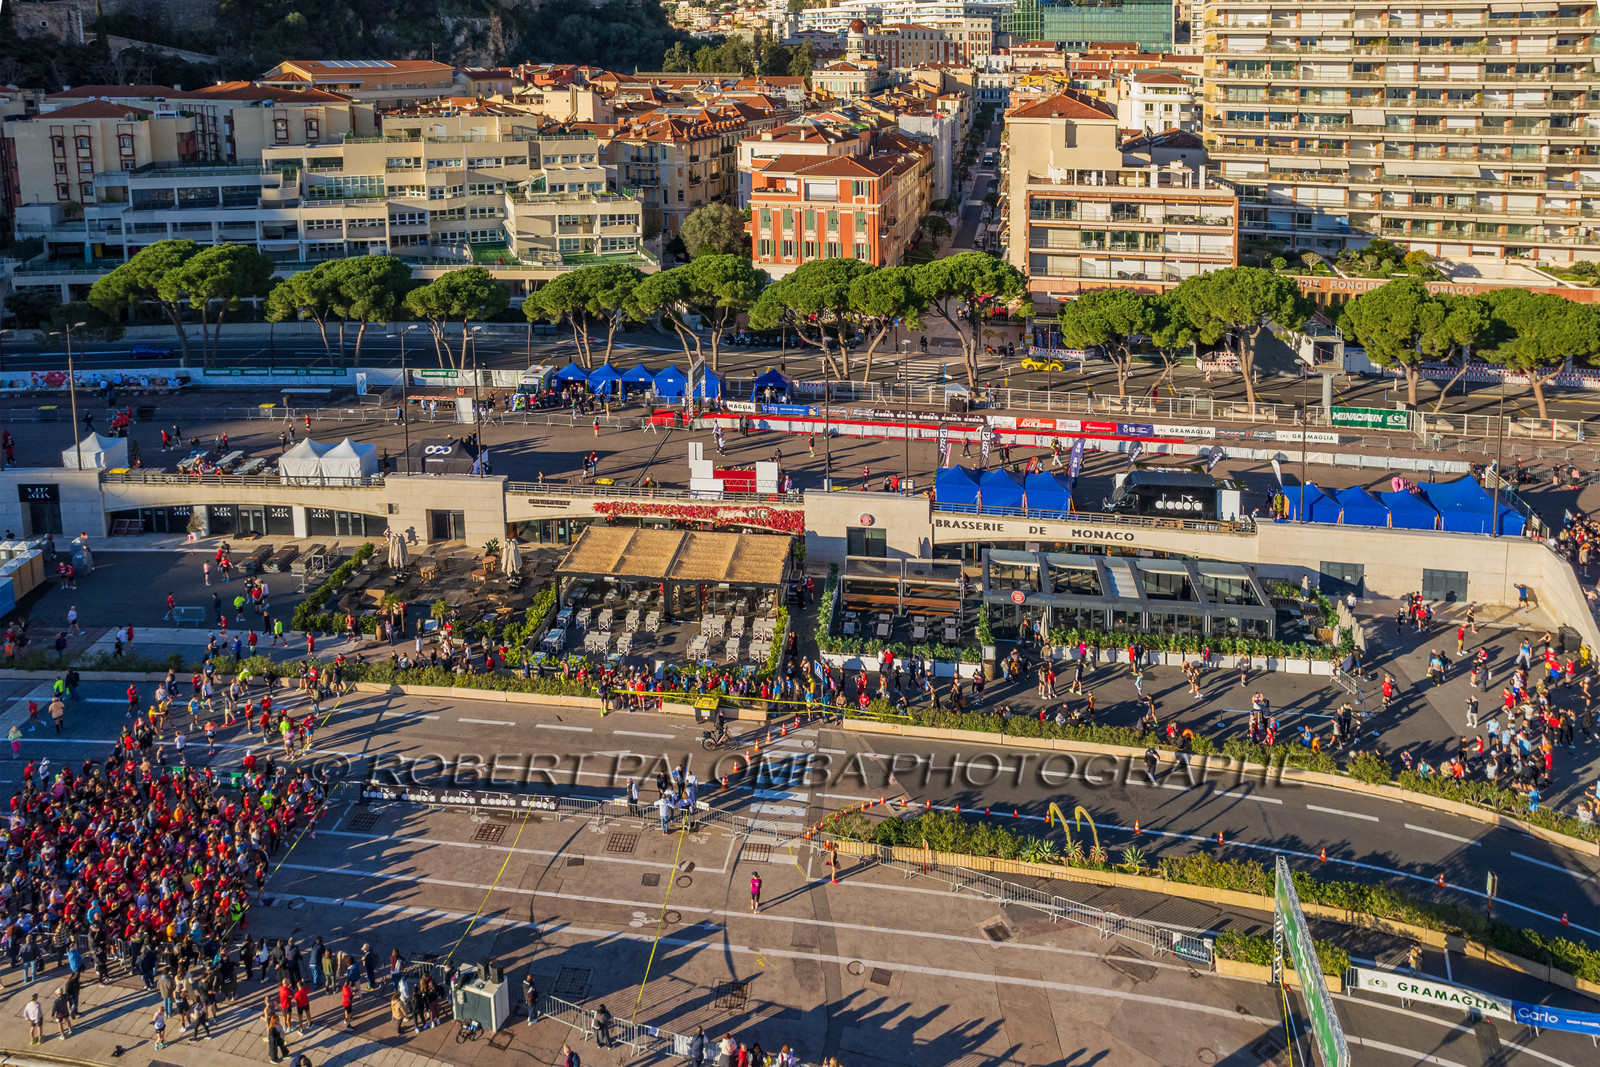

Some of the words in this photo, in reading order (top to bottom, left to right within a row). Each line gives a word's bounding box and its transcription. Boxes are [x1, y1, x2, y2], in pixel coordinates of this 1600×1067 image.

[896, 410, 916, 419] diaora
[1169, 427, 1211, 435] GRAMAGLIA
[1155, 493, 1203, 512] diadora
[935, 519, 1004, 532] BRASSERIE
[1029, 525, 1047, 535] DE
[1071, 528, 1135, 541] MONACO
[401, 788, 436, 802] diadora
[440, 790, 476, 804] diadora
[480, 793, 516, 807] diadora
[521, 795, 556, 810] diadora
[1397, 982, 1500, 1011] GRAMAGLIA
[1518, 1007, 1559, 1024] Carlo
